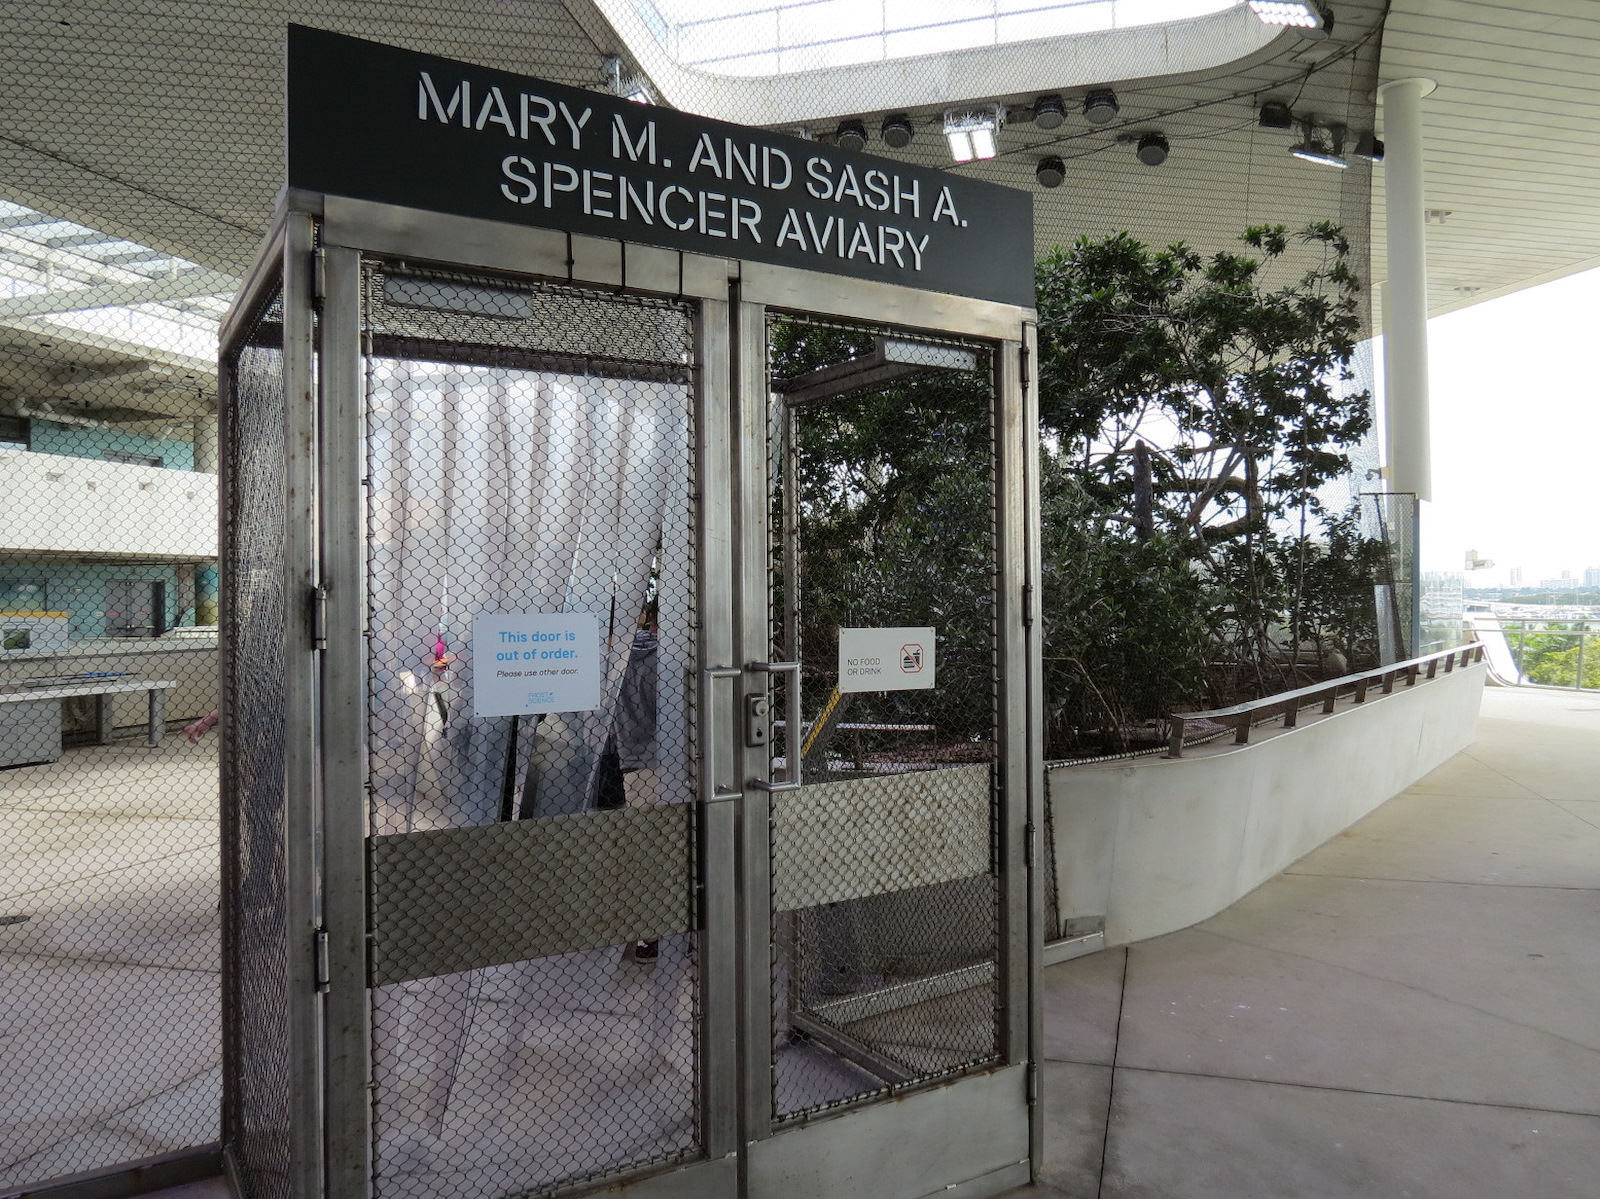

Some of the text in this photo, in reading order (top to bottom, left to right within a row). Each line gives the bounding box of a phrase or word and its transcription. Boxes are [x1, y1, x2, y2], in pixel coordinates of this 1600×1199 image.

[417, 71, 968, 228] MARY M. AND SASH A.
[500, 154, 929, 272] SPENCER AVIARY
[499, 630, 576, 643] This door is
[496, 648, 578, 661] out of order.
[847, 658, 880, 666] NO FOOD
[496, 670, 522, 678] Please
[539, 668, 559, 676] other
[847, 667, 881, 676] OR DRINK
